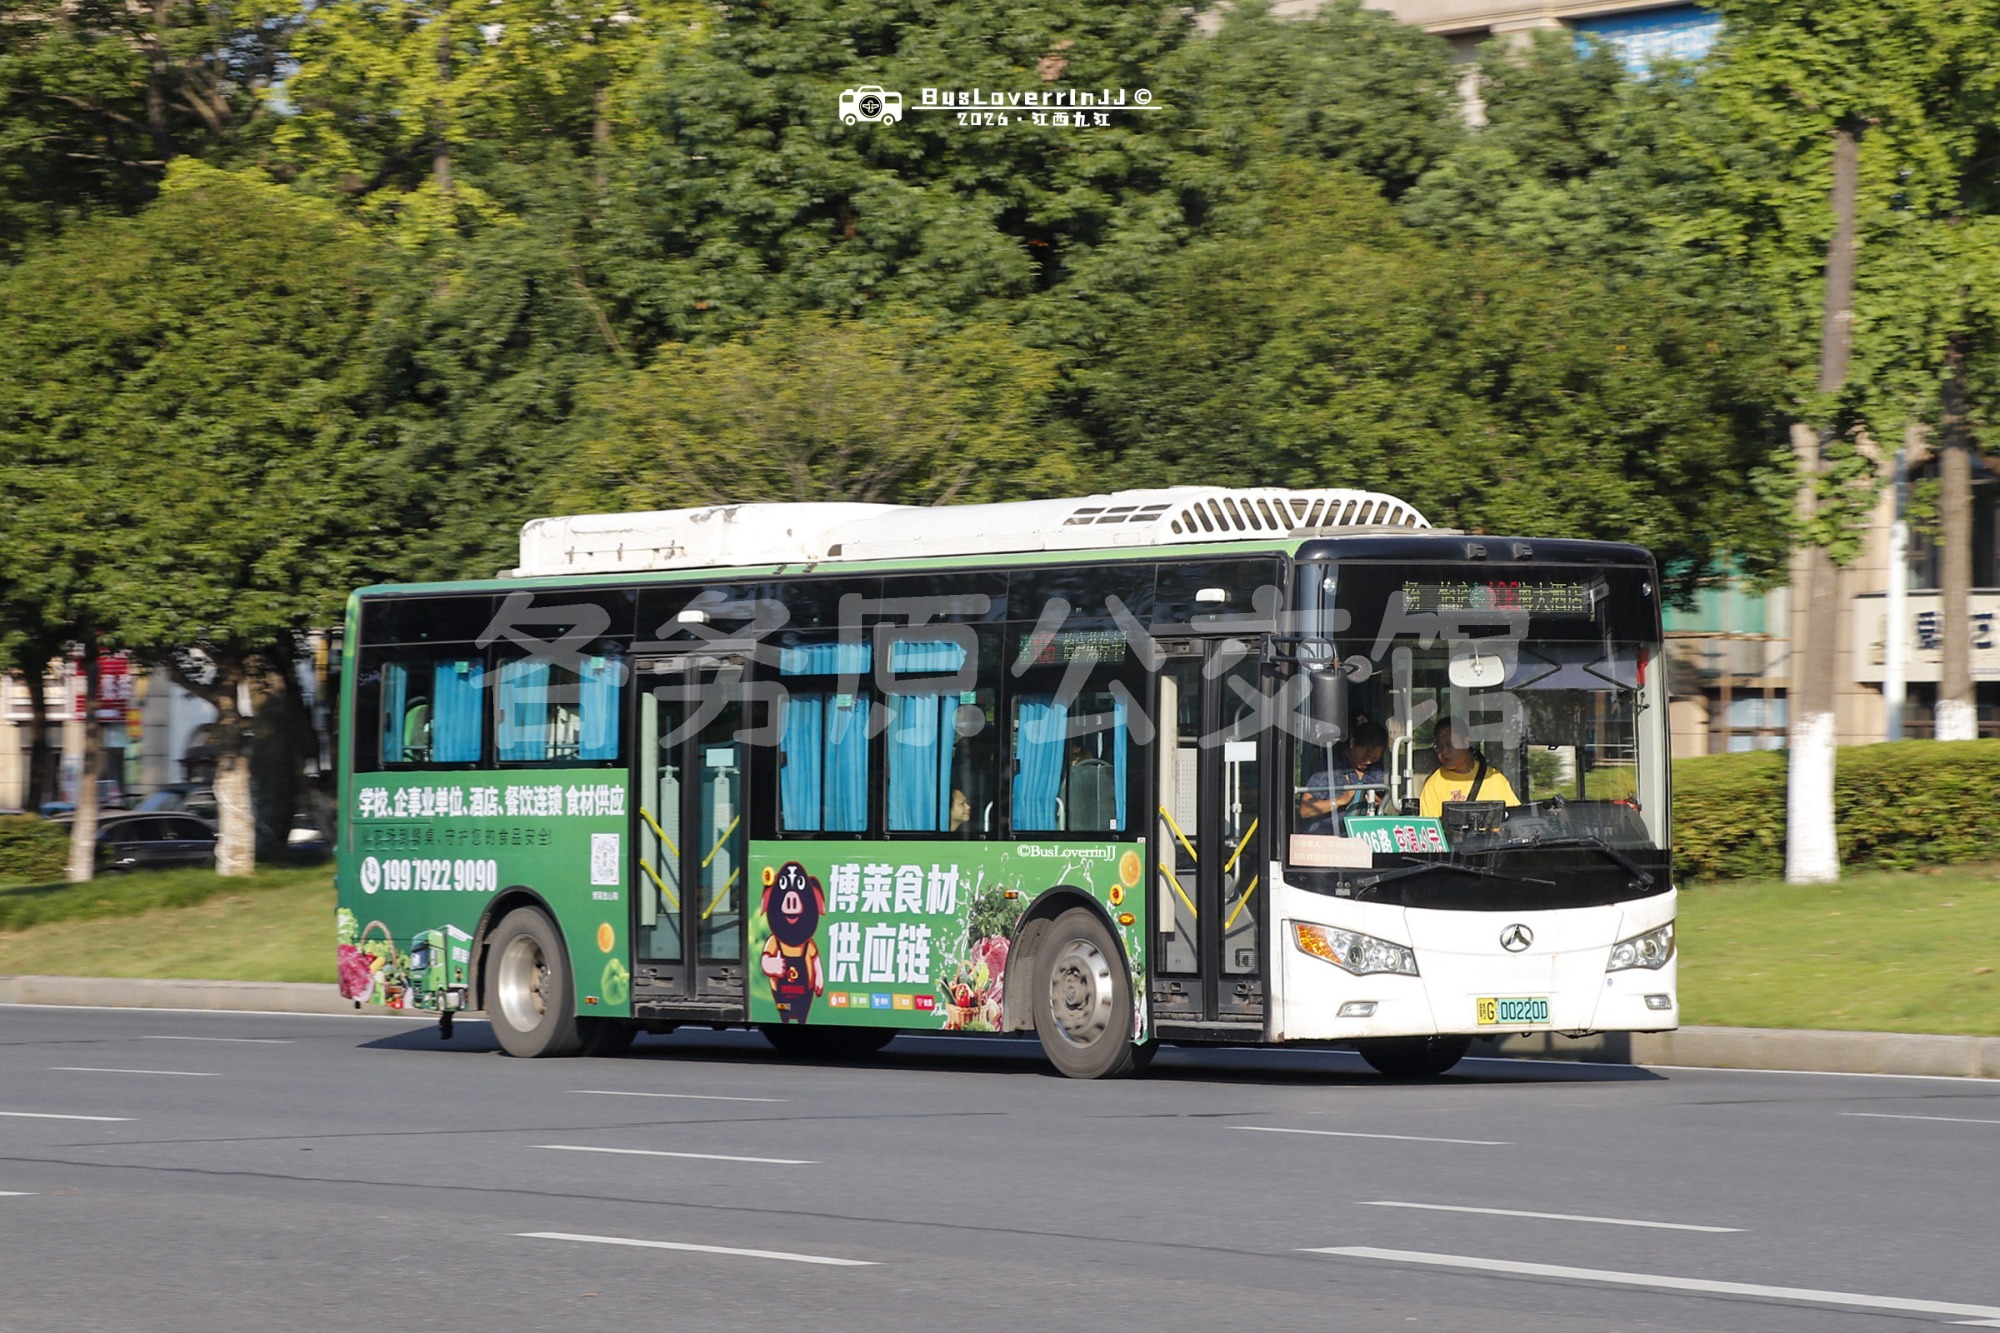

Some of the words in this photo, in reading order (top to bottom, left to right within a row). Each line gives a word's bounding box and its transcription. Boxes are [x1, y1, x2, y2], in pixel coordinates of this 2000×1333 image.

[454, 859, 497, 891] 9090
[828, 863, 960, 915] 博莱食材
[828, 921, 932, 985] 供应链
[1501, 1001, 1548, 1020] 00220D
